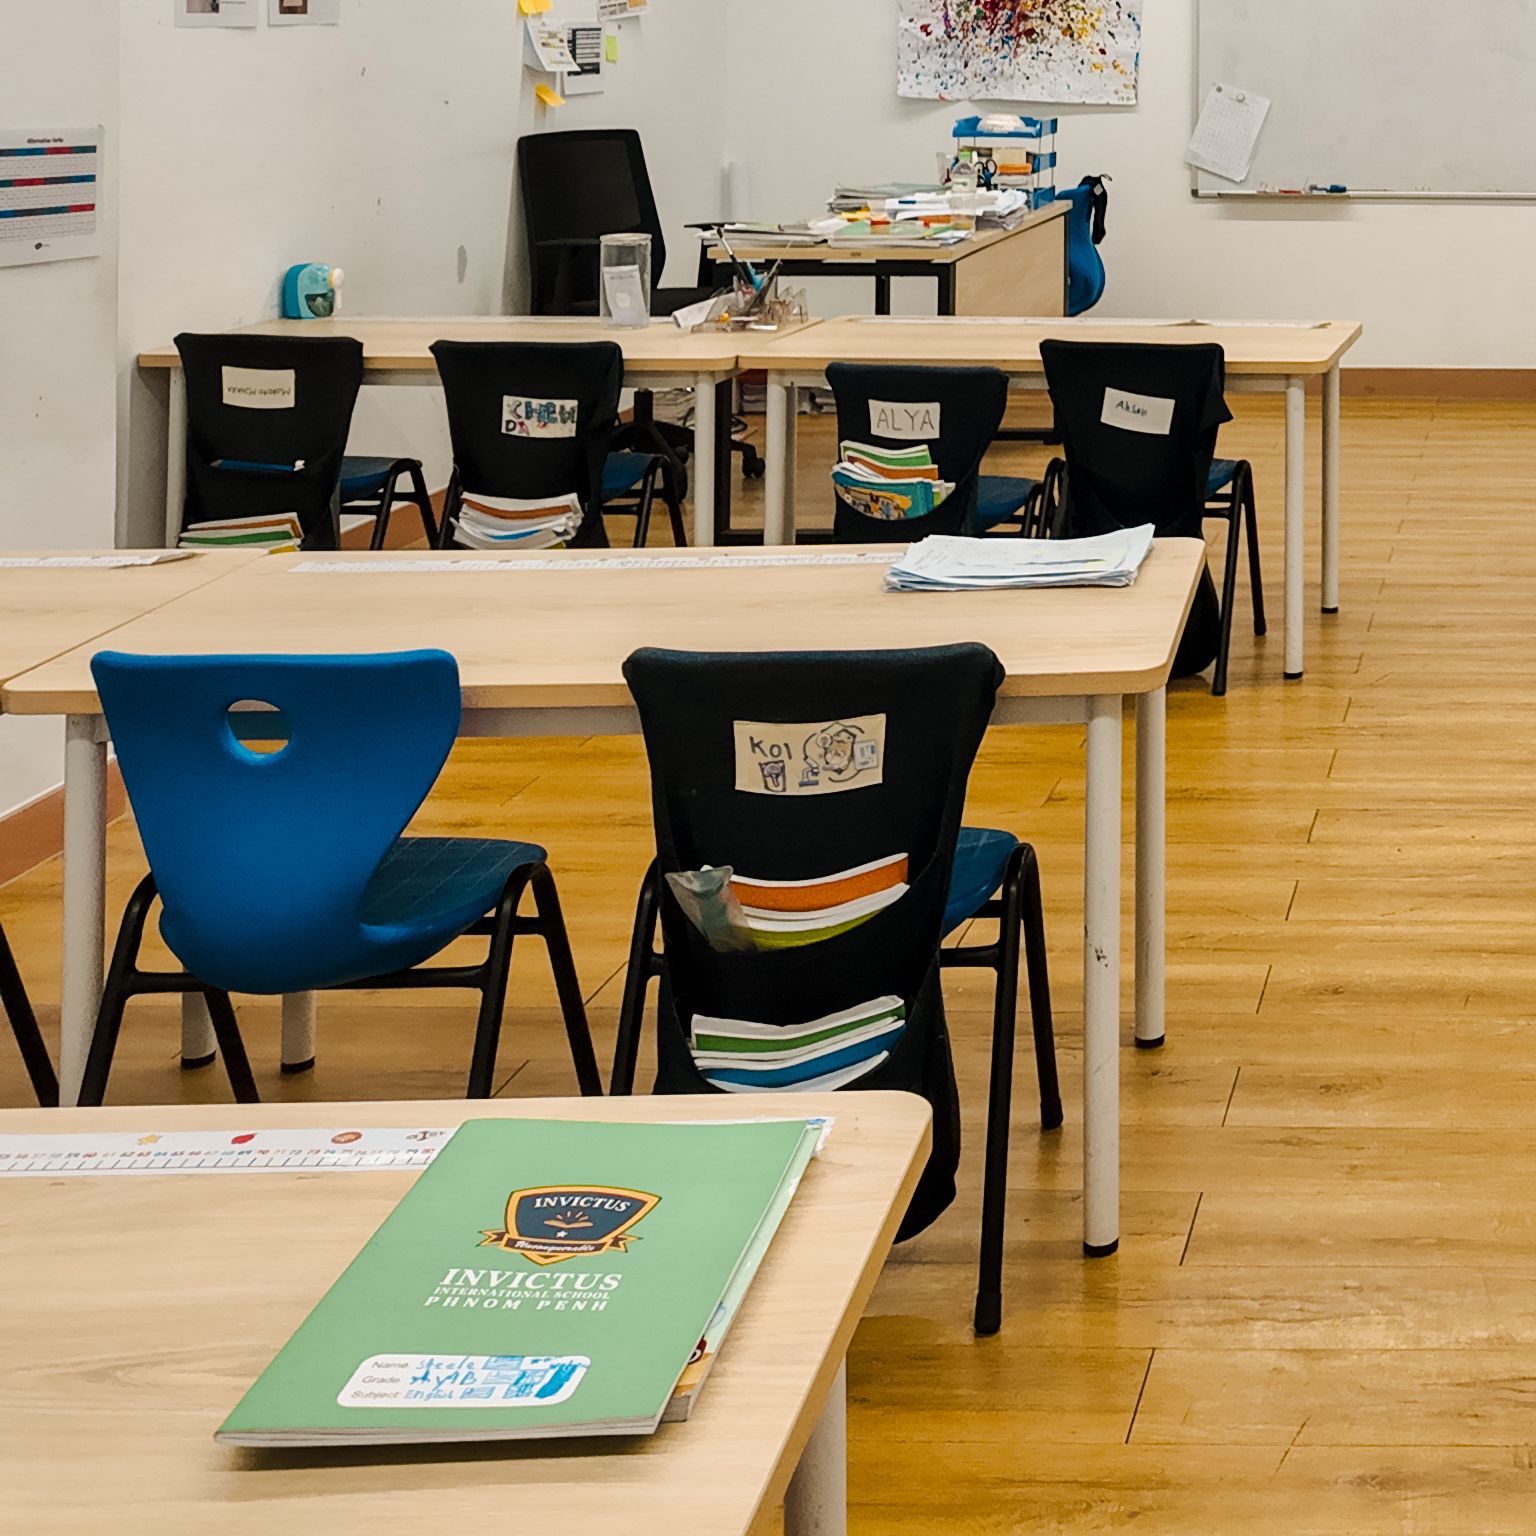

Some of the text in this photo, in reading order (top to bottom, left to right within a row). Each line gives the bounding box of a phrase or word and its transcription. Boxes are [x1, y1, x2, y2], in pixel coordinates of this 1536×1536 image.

[876, 408, 935, 431] ALYA
[533, 1196, 632, 1212] INVICTUS
[439, 1268, 623, 1291] INVICTUS
[433, 1286, 611, 1300] INTERNATIONAL SCHOOL
[424, 1296, 609, 1312] PHNOM PENH
[371, 1360, 409, 1370] Name
[361, 1375, 401, 1384] Grade
[351, 1390, 399, 1400] Subject
